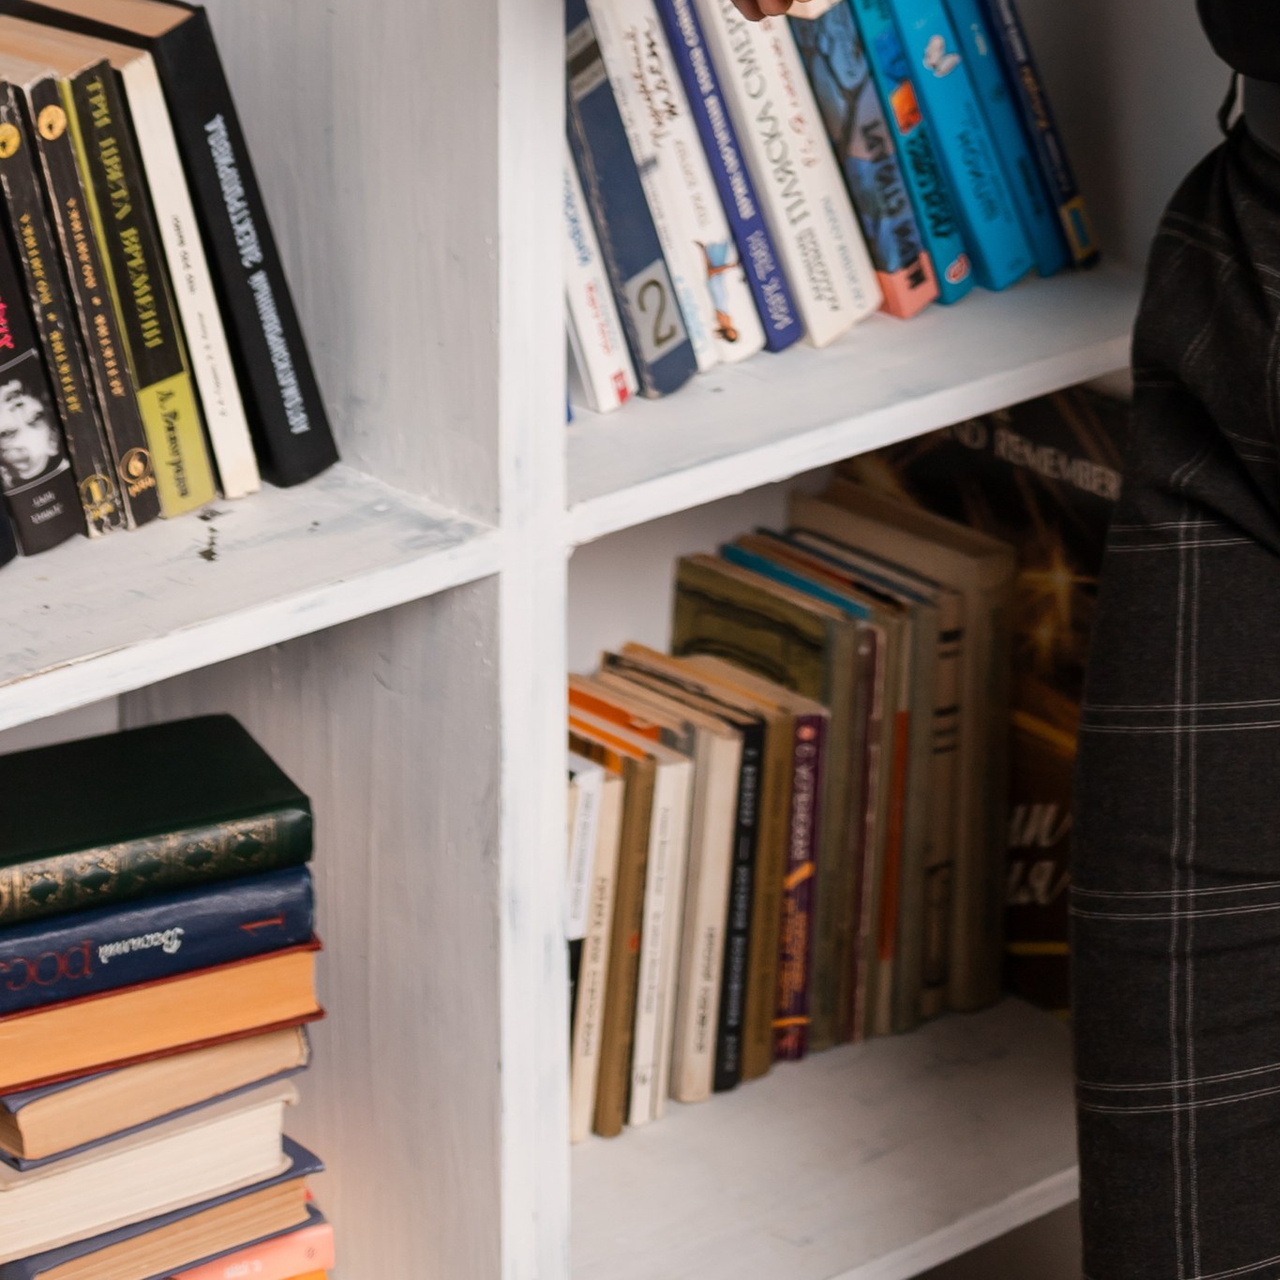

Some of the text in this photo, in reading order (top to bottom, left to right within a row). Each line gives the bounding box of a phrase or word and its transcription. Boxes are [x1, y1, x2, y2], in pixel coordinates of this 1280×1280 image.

[86, 77, 163, 348] ТРИ ЦВЕТА ВРЕМЕНИ
[759, 97, 813, 228] ПЛЯСКА
[637, 278, 677, 350] 2
[97, 926, 185, 964] Василий
